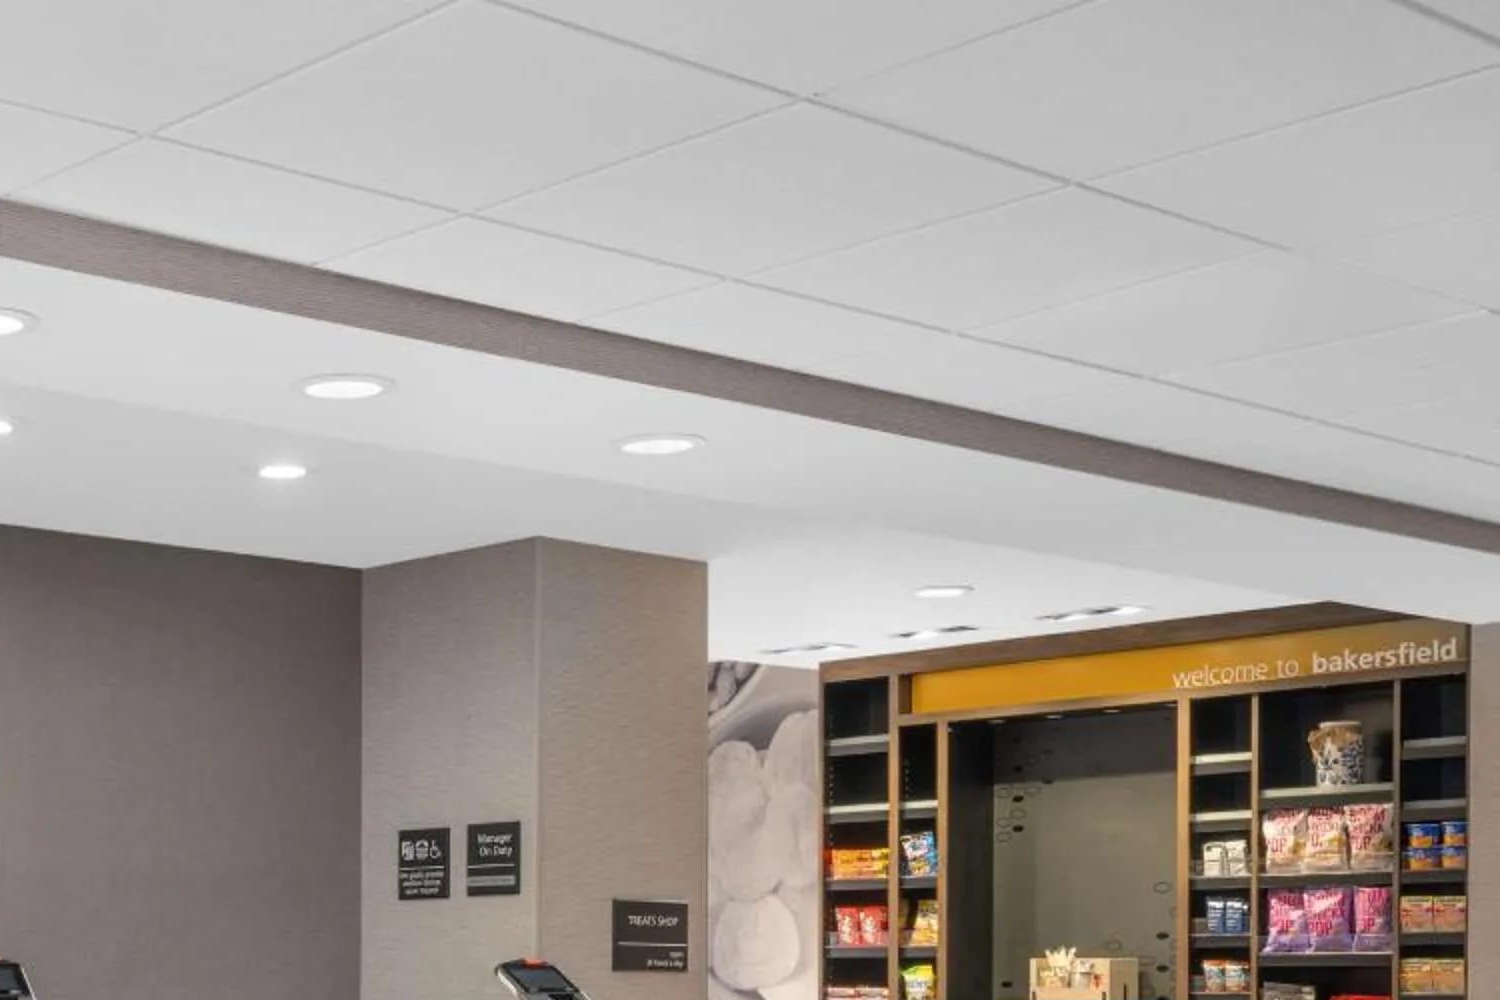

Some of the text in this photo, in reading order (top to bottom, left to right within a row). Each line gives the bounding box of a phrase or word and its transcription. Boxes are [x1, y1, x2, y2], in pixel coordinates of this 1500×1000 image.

[1172, 637, 1458, 689] welcome to bakersfield
[477, 833, 512, 845] Manager
[479, 845, 513, 858] On Duty
[627, 914, 679, 927] TREATS SHOP
